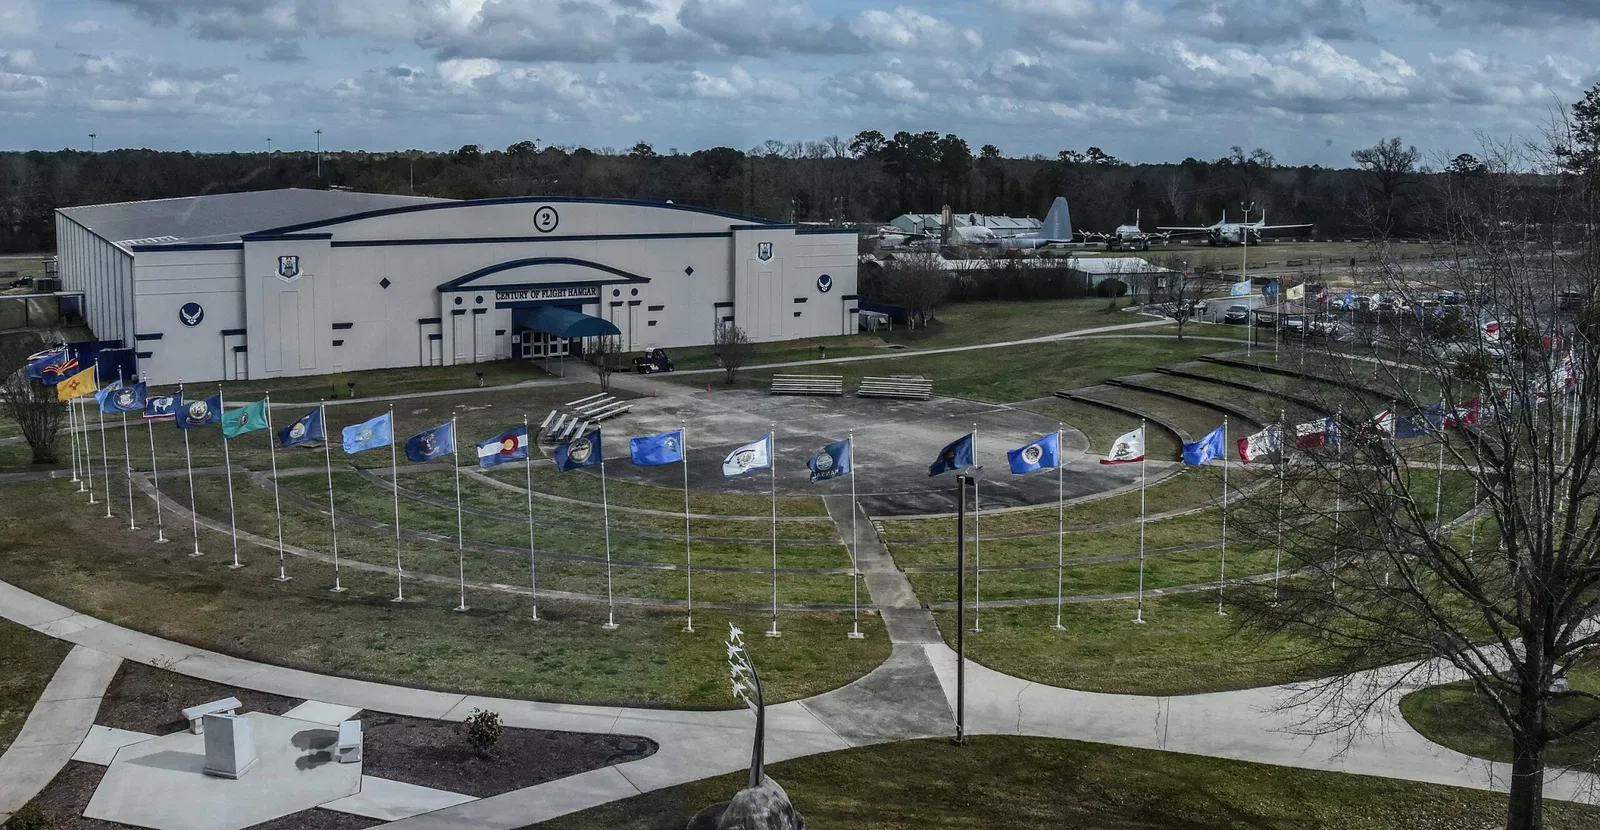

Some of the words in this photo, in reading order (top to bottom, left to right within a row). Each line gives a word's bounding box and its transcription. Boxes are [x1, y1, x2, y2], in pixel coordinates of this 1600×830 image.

[541, 213, 551, 225] 2
[495, 290, 529, 300] CENTURY
[531, 289, 541, 299] OF
[541, 288, 567, 298] FLIGHT
[568, 287, 597, 297] HANGAR
